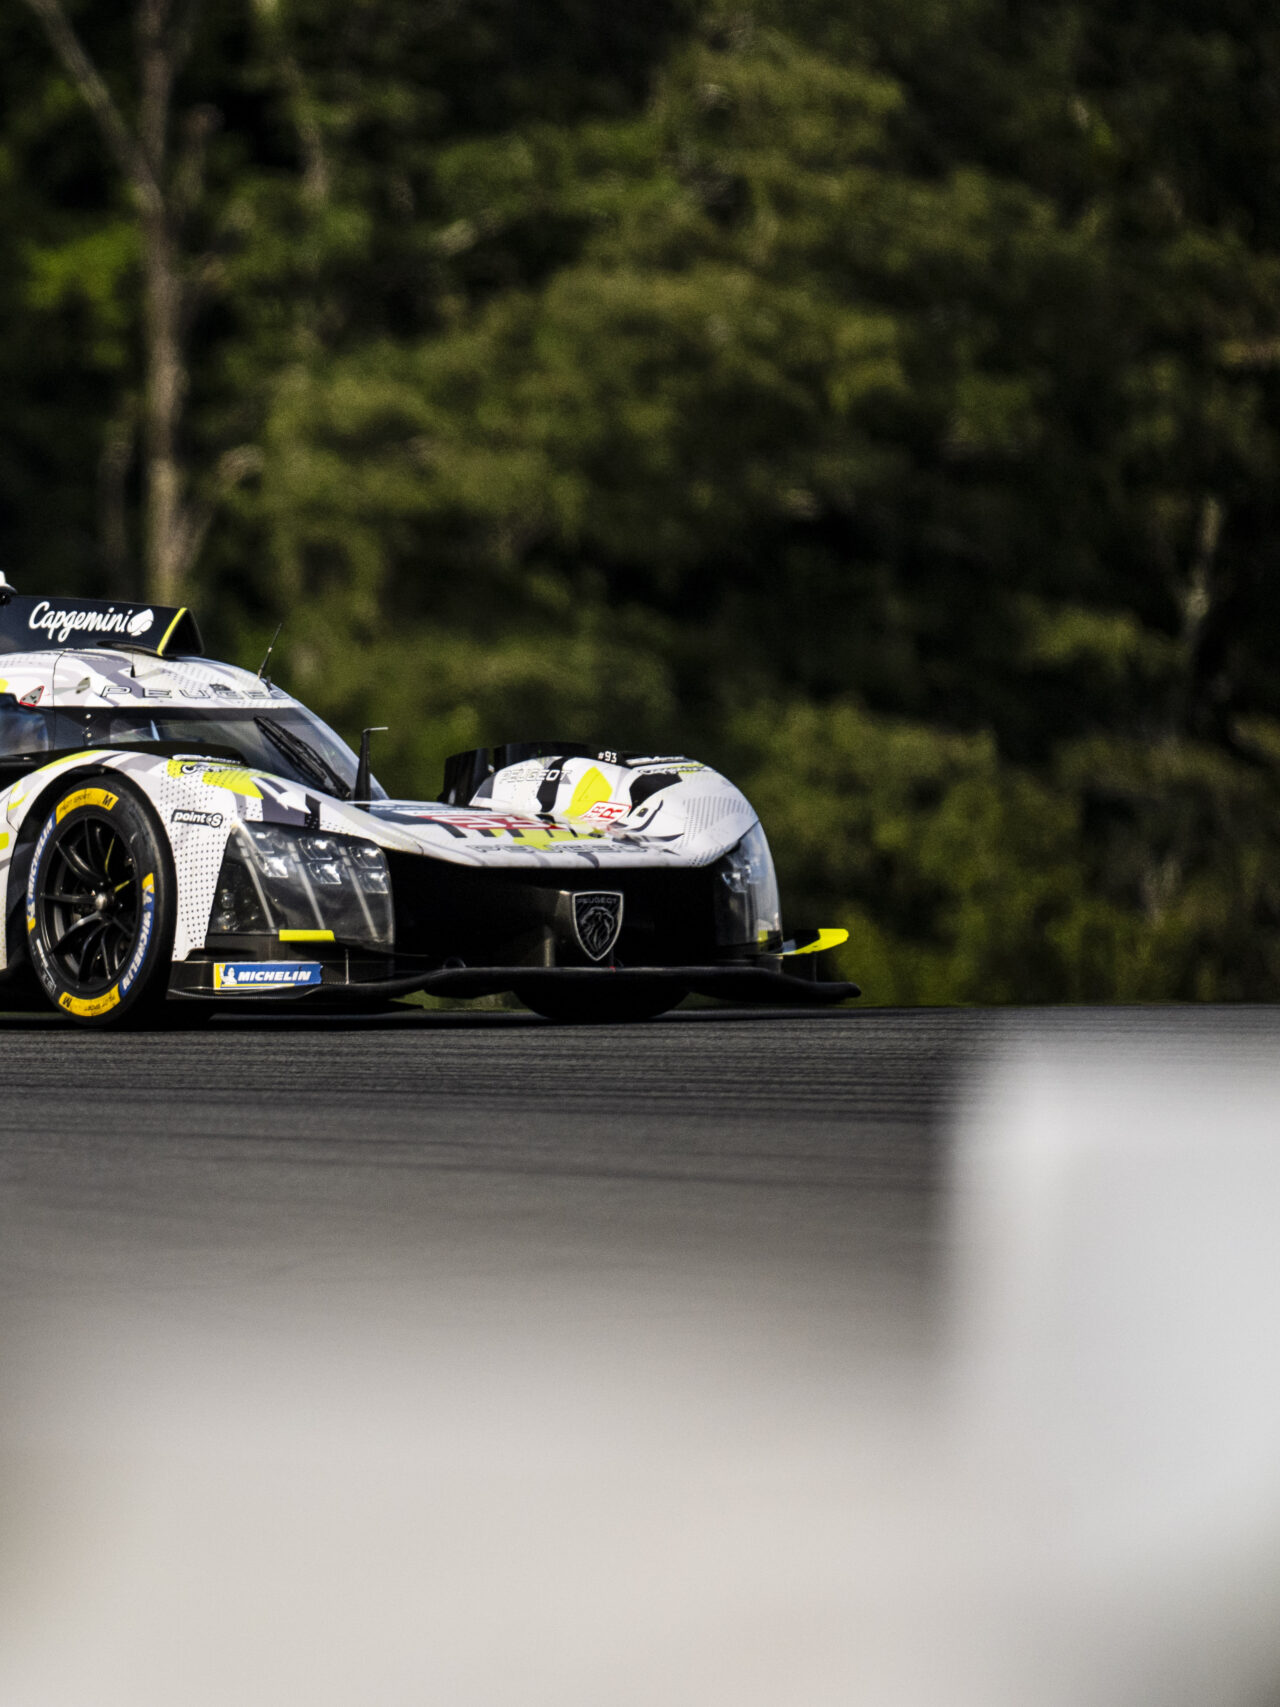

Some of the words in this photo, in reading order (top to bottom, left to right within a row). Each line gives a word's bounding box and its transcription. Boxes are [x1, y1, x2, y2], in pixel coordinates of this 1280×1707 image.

[28, 600, 129, 642] Capgemini
[598, 751, 618, 763] #93
[173, 811, 207, 823] point
[28, 815, 54, 900] MICHELIN
[122, 911, 152, 990] MICHELIN
[237, 969, 312, 984] MICHELIN
